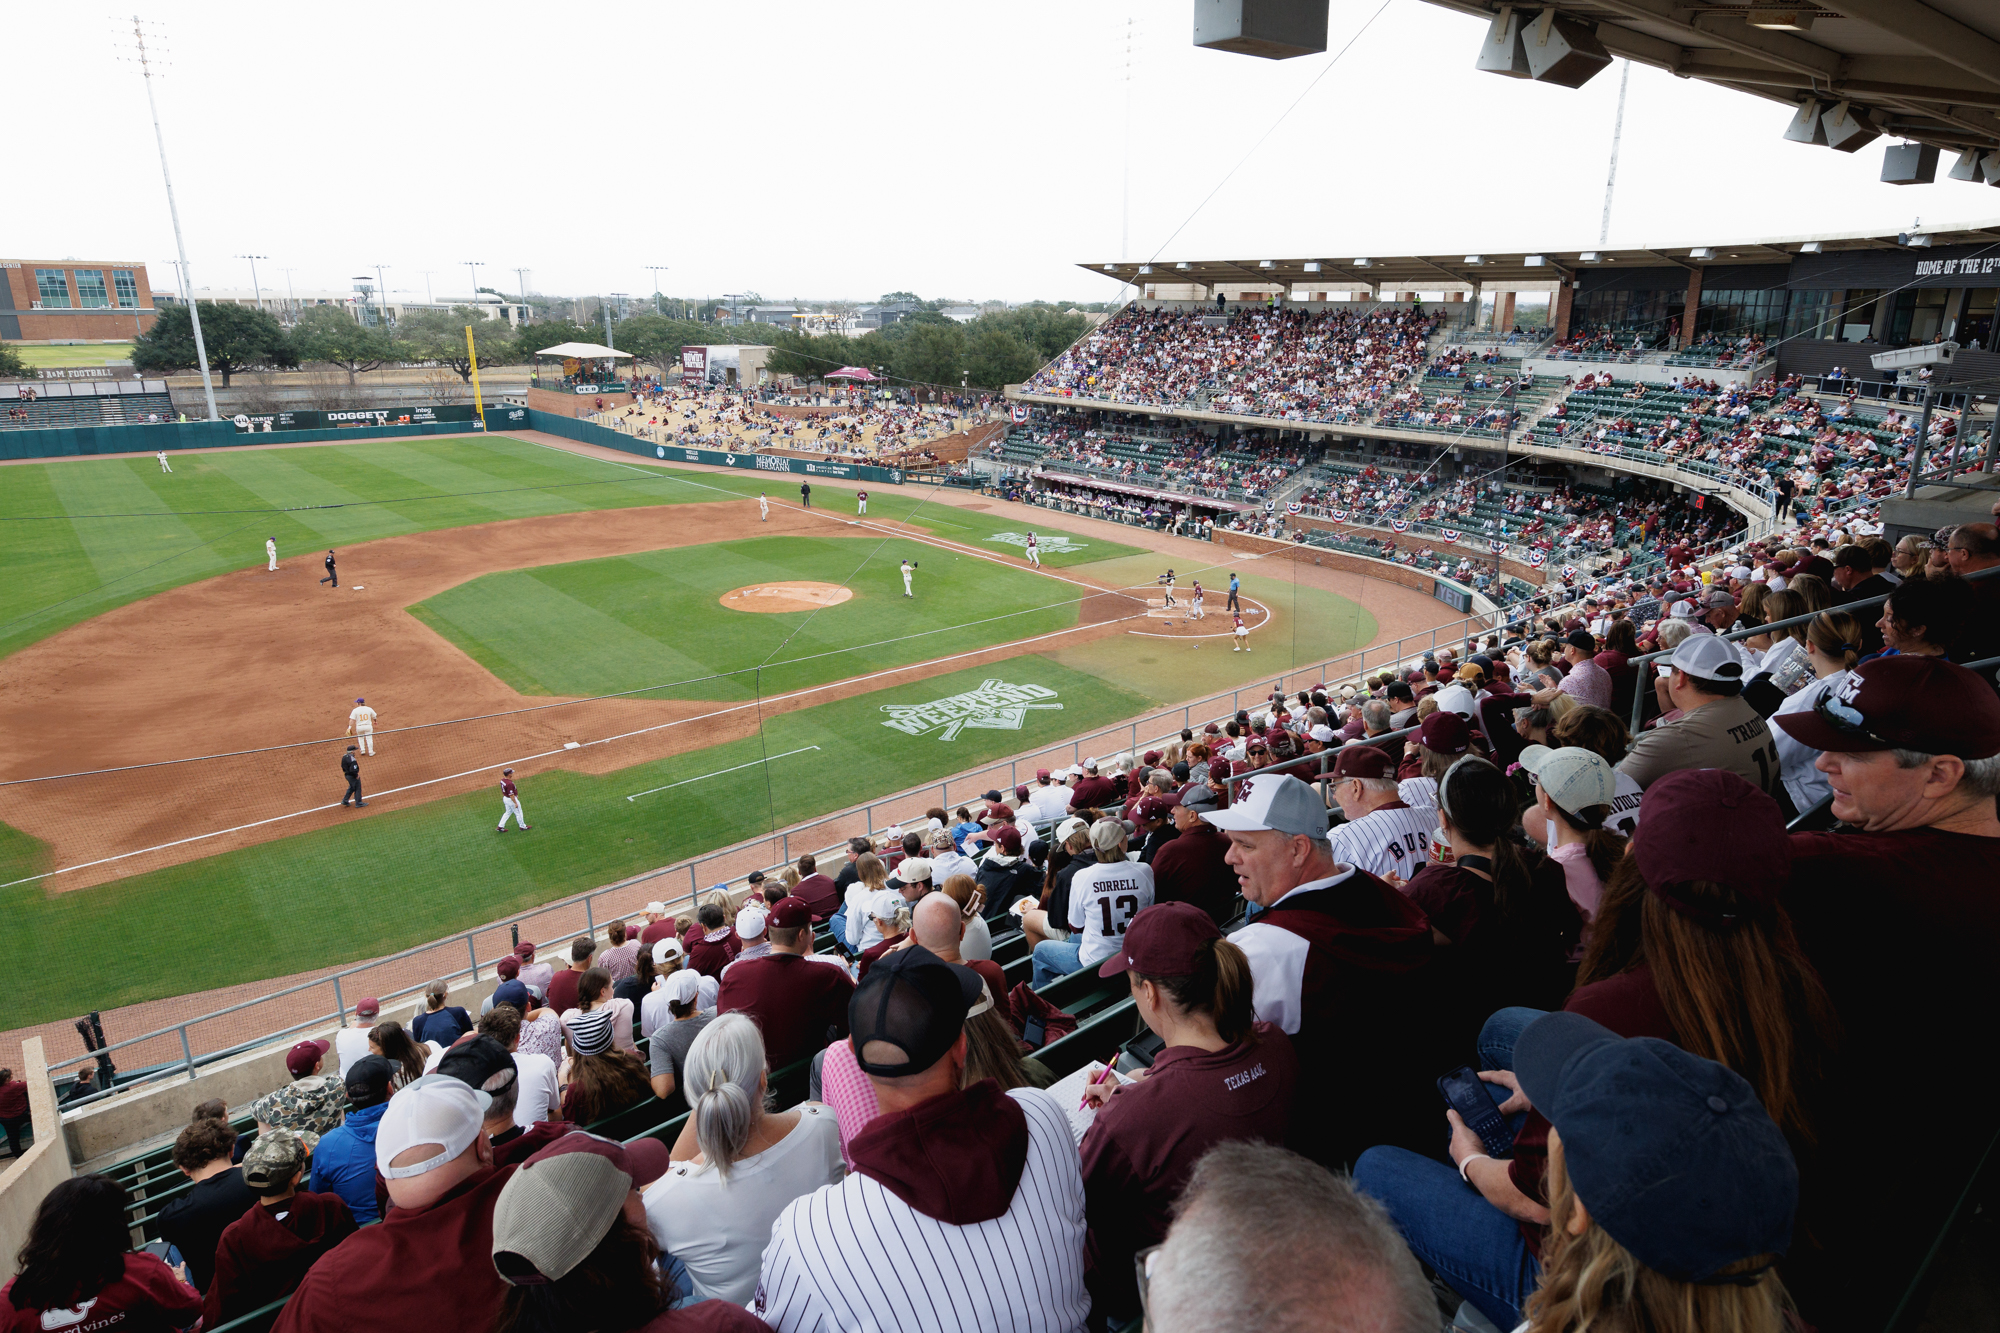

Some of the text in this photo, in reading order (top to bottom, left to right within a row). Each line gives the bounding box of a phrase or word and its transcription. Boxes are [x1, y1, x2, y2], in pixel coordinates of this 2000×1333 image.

[1915, 260, 1943, 275] HOME
[1943, 259, 1958, 275] OF
[1960, 258, 1981, 274] THE
[68, 369, 113, 378] FOOTBALL
[328, 410, 389, 421] DOGGETT
[756, 455, 790, 466] MEMORIAL
[756, 462, 790, 472] HERMANN
[1440, 584, 1464, 610] YETI
[880, 683, 1058, 735] WEEKEND
[359, 713, 369, 722] 10
[1093, 879, 1139, 893] SORRELL
[1097, 894, 1139, 937] 13
[1224, 1070, 1251, 1091] TEXAS
[83, 1311, 126, 1332] vines
